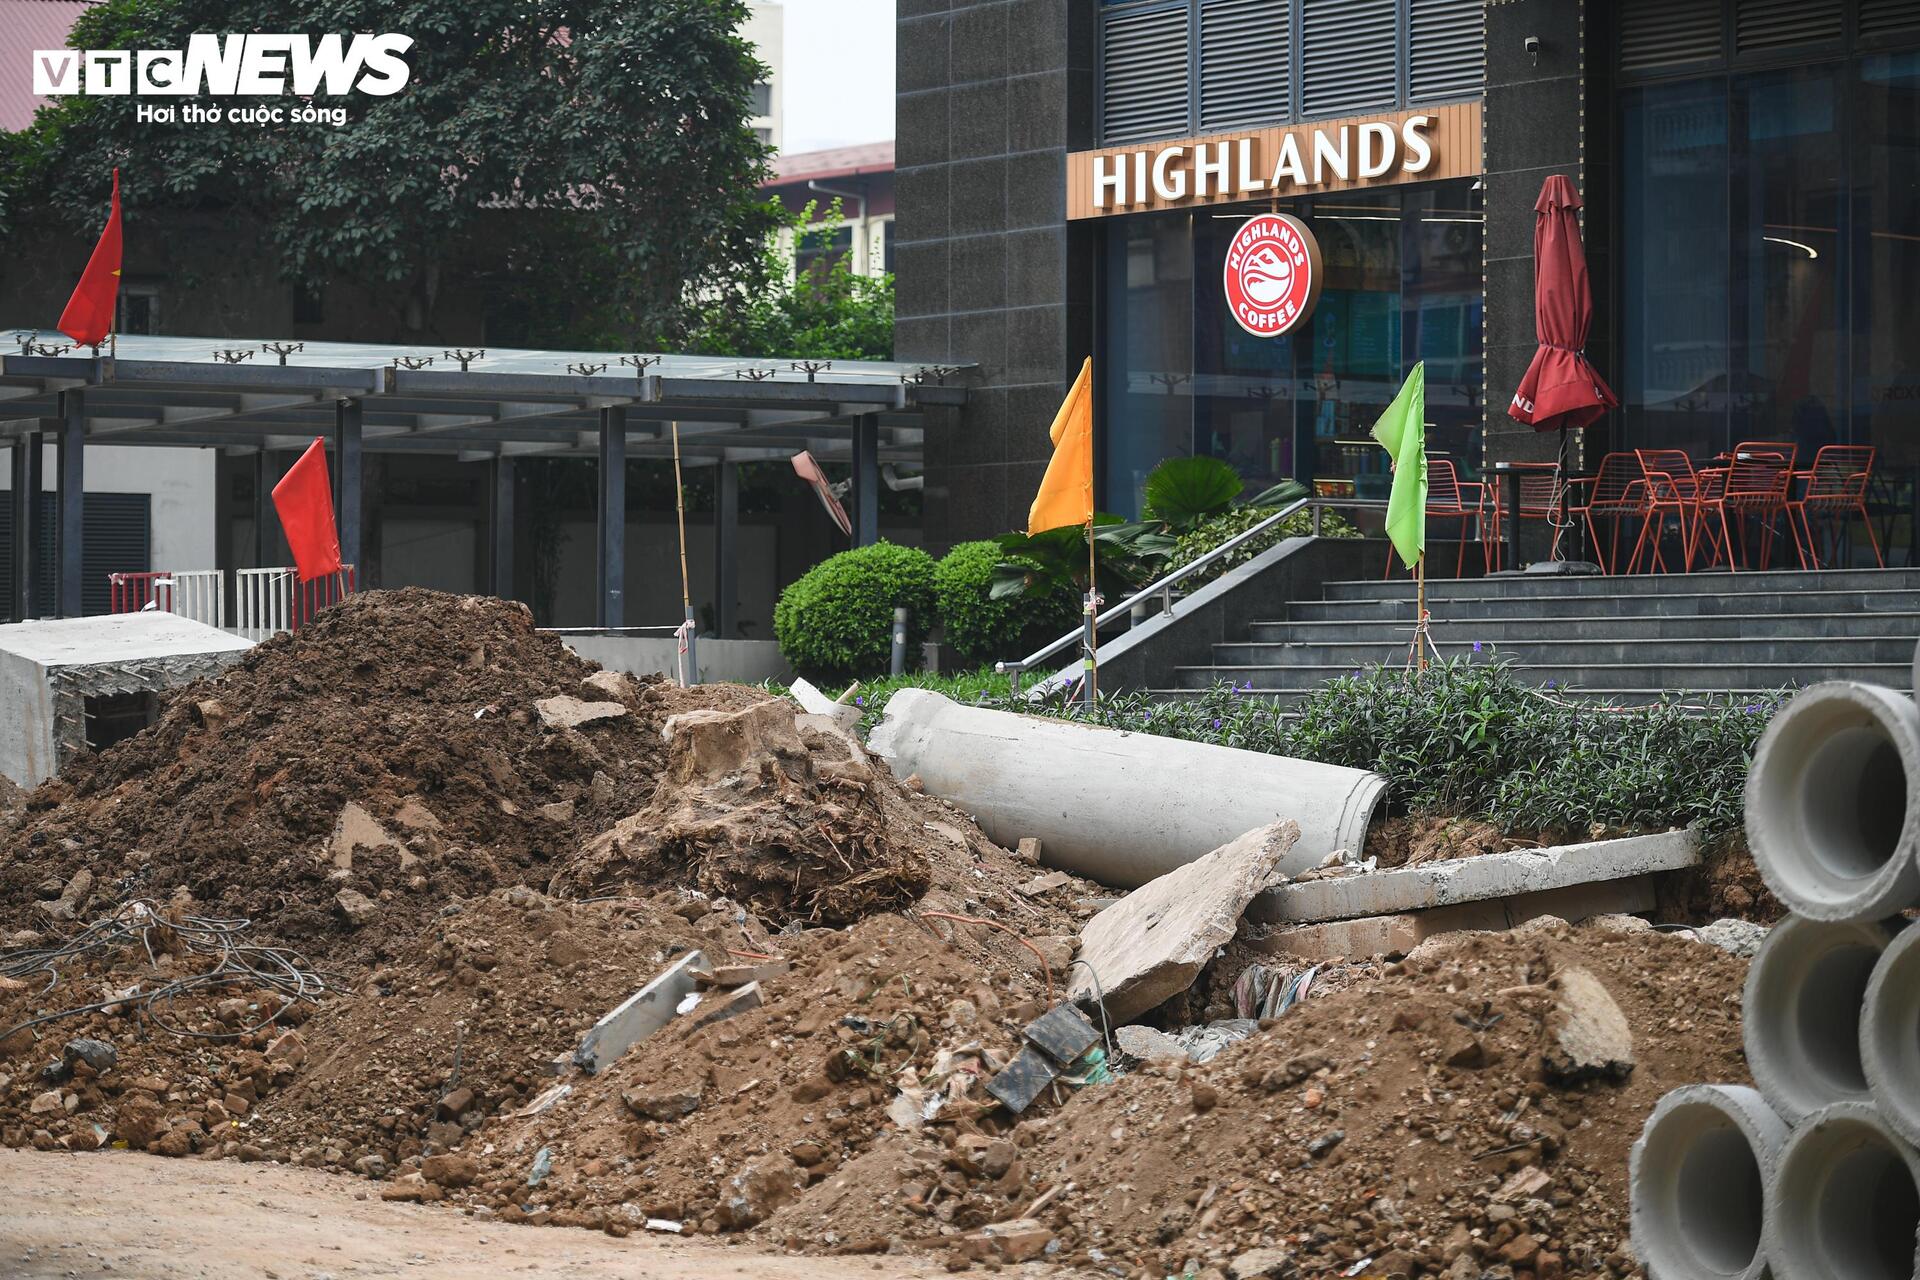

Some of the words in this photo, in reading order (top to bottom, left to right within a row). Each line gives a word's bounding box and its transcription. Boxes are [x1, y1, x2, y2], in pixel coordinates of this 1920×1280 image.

[1093, 115, 1438, 209] HIGHLANDS
[1230, 222, 1304, 271] HIGHLANDS
[1239, 300, 1296, 328] COFFEE
